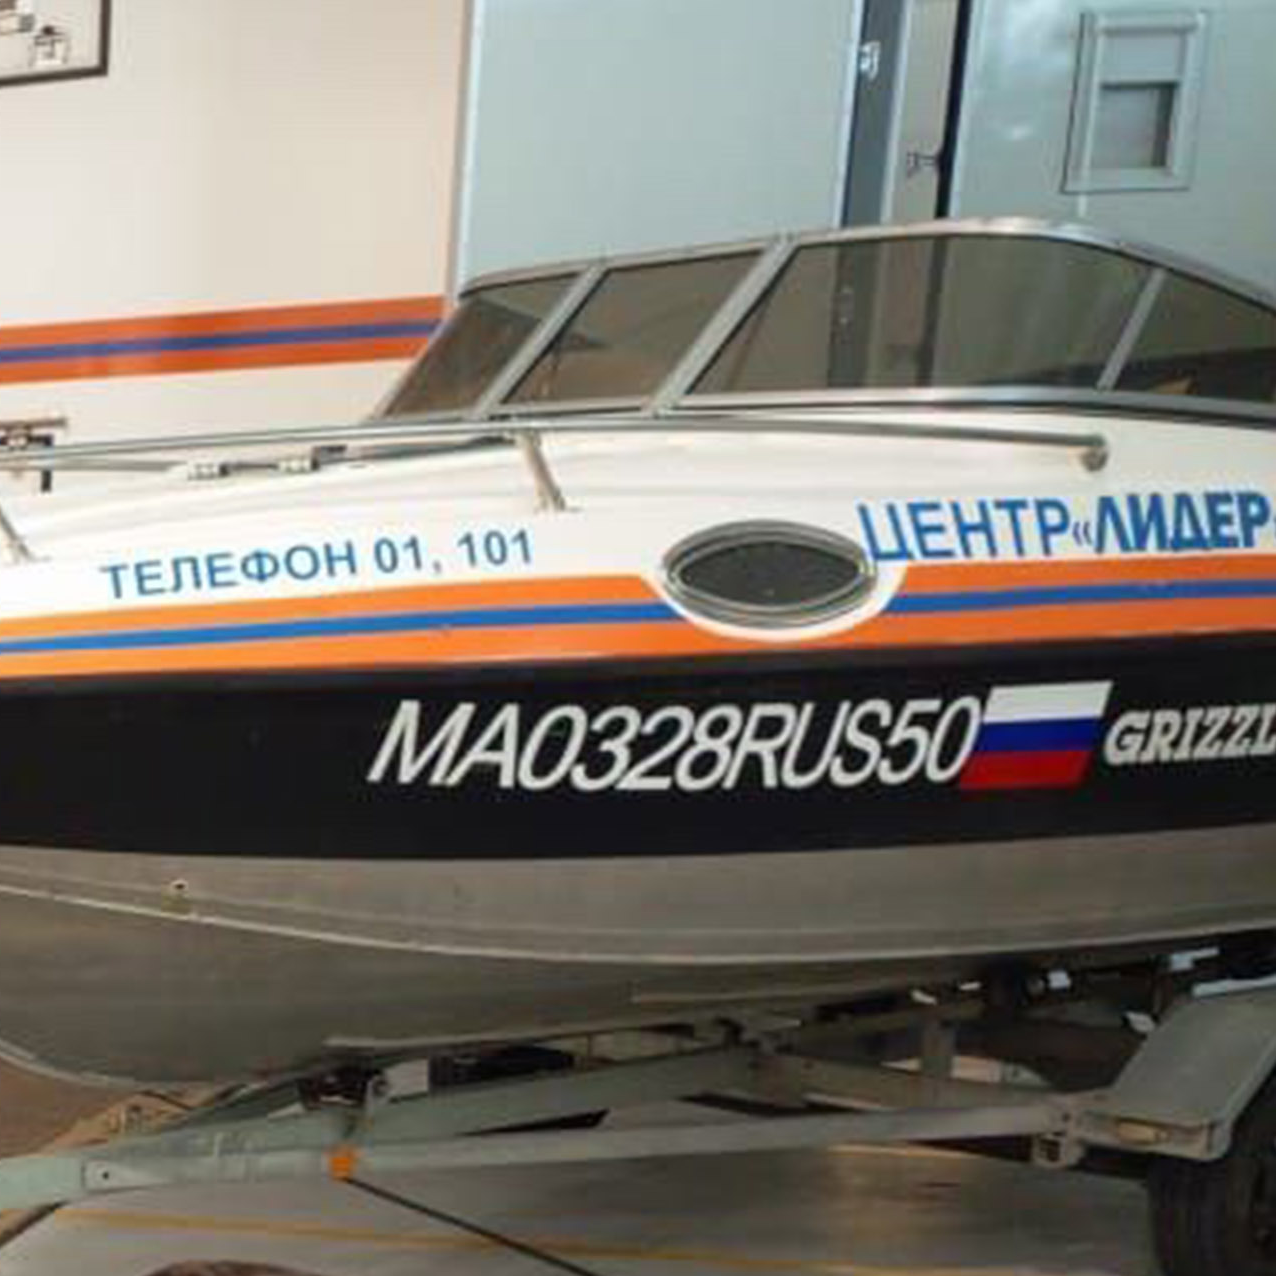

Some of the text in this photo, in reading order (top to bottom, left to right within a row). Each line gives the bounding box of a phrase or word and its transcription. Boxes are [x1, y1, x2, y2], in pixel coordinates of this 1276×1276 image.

[857, 499, 1070, 560] ЦЕНТР
[99, 528, 533, 599] ТЕЛЕФОН 01, 101
